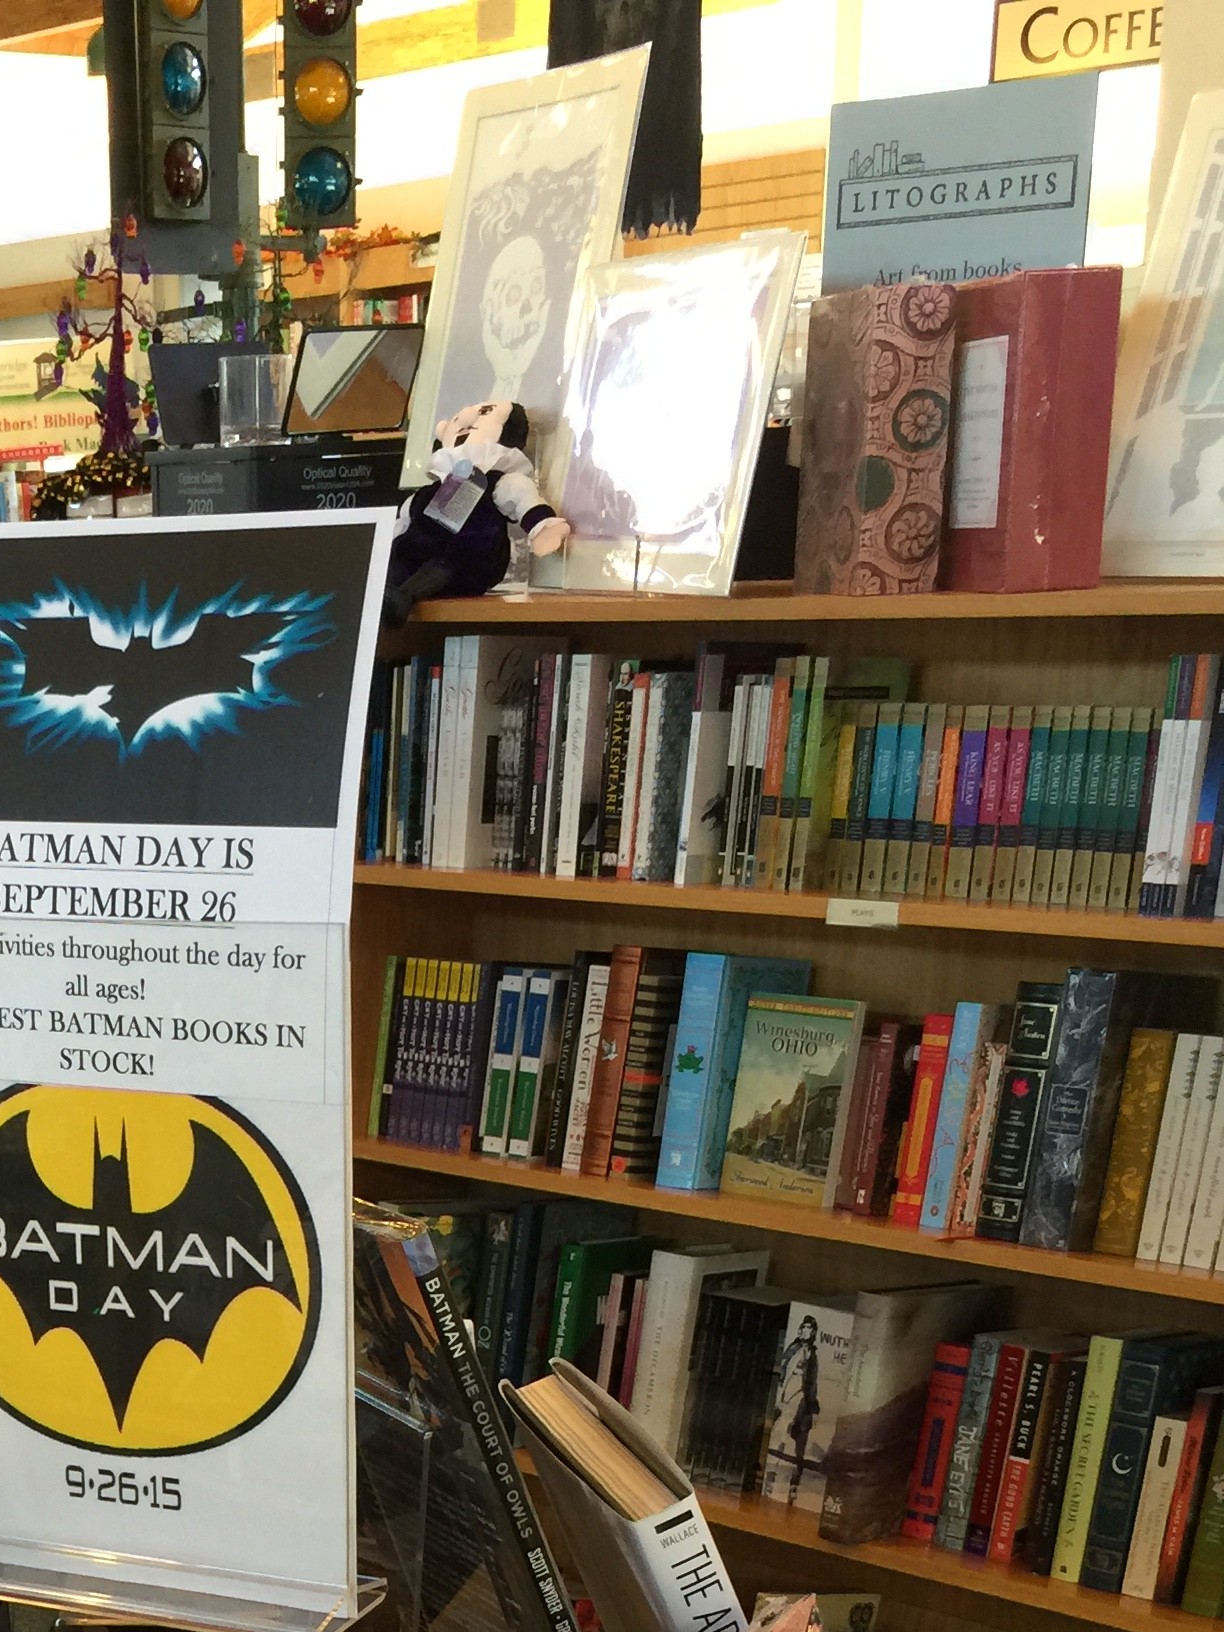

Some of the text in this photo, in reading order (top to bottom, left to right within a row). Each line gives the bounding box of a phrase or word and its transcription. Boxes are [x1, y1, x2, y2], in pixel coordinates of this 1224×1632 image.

[851, 170, 1060, 214] LITOGRAPHS
[873, 266, 904, 288] Art
[962, 257, 1024, 280] books
[303, 465, 372, 481] Optical Quality
[316, 491, 357, 510] 2020
[605, 700, 623, 814] SHAKESPEARE
[134, 835, 214, 869] DAY
[223, 837, 256, 871] IS
[200, 891, 237, 923] 26
[61, 936, 181, 967] throughout
[186, 940, 221, 967] the
[226, 944, 267, 973] day
[272, 945, 308, 971] for
[65, 975, 146, 1004] all ages!
[48, 1010, 165, 1040] BATMAN
[171, 1017, 268, 1047] BOOKS
[276, 1022, 307, 1049] IN
[575, 979, 608, 1092] Little Women
[59, 1047, 155, 1077] STOCK!
[771, 1036, 818, 1058] OHIO
[48, 1279, 184, 1322] DAY
[1028, 1361, 1044, 1400] PEARL
[424, 1277, 466, 1360] BATMAN
[456, 1360, 477, 1399] THE
[472, 1400, 506, 1459] COURT
[495, 1462, 514, 1487] OF
[506, 1488, 533, 1540] OWLS
[526, 1546, 545, 1578] SCOTT
[536, 1574, 560, 1614] SNYDER
[953, 1423, 980, 1467] JANE
[1015, 1421, 1032, 1452] BUCK
[1012, 1463, 1023, 1488] THE
[1006, 1489, 1020, 1515] GOOD
[659, 1522, 700, 1550] WALLACE
[670, 1542, 724, 1607] THE
